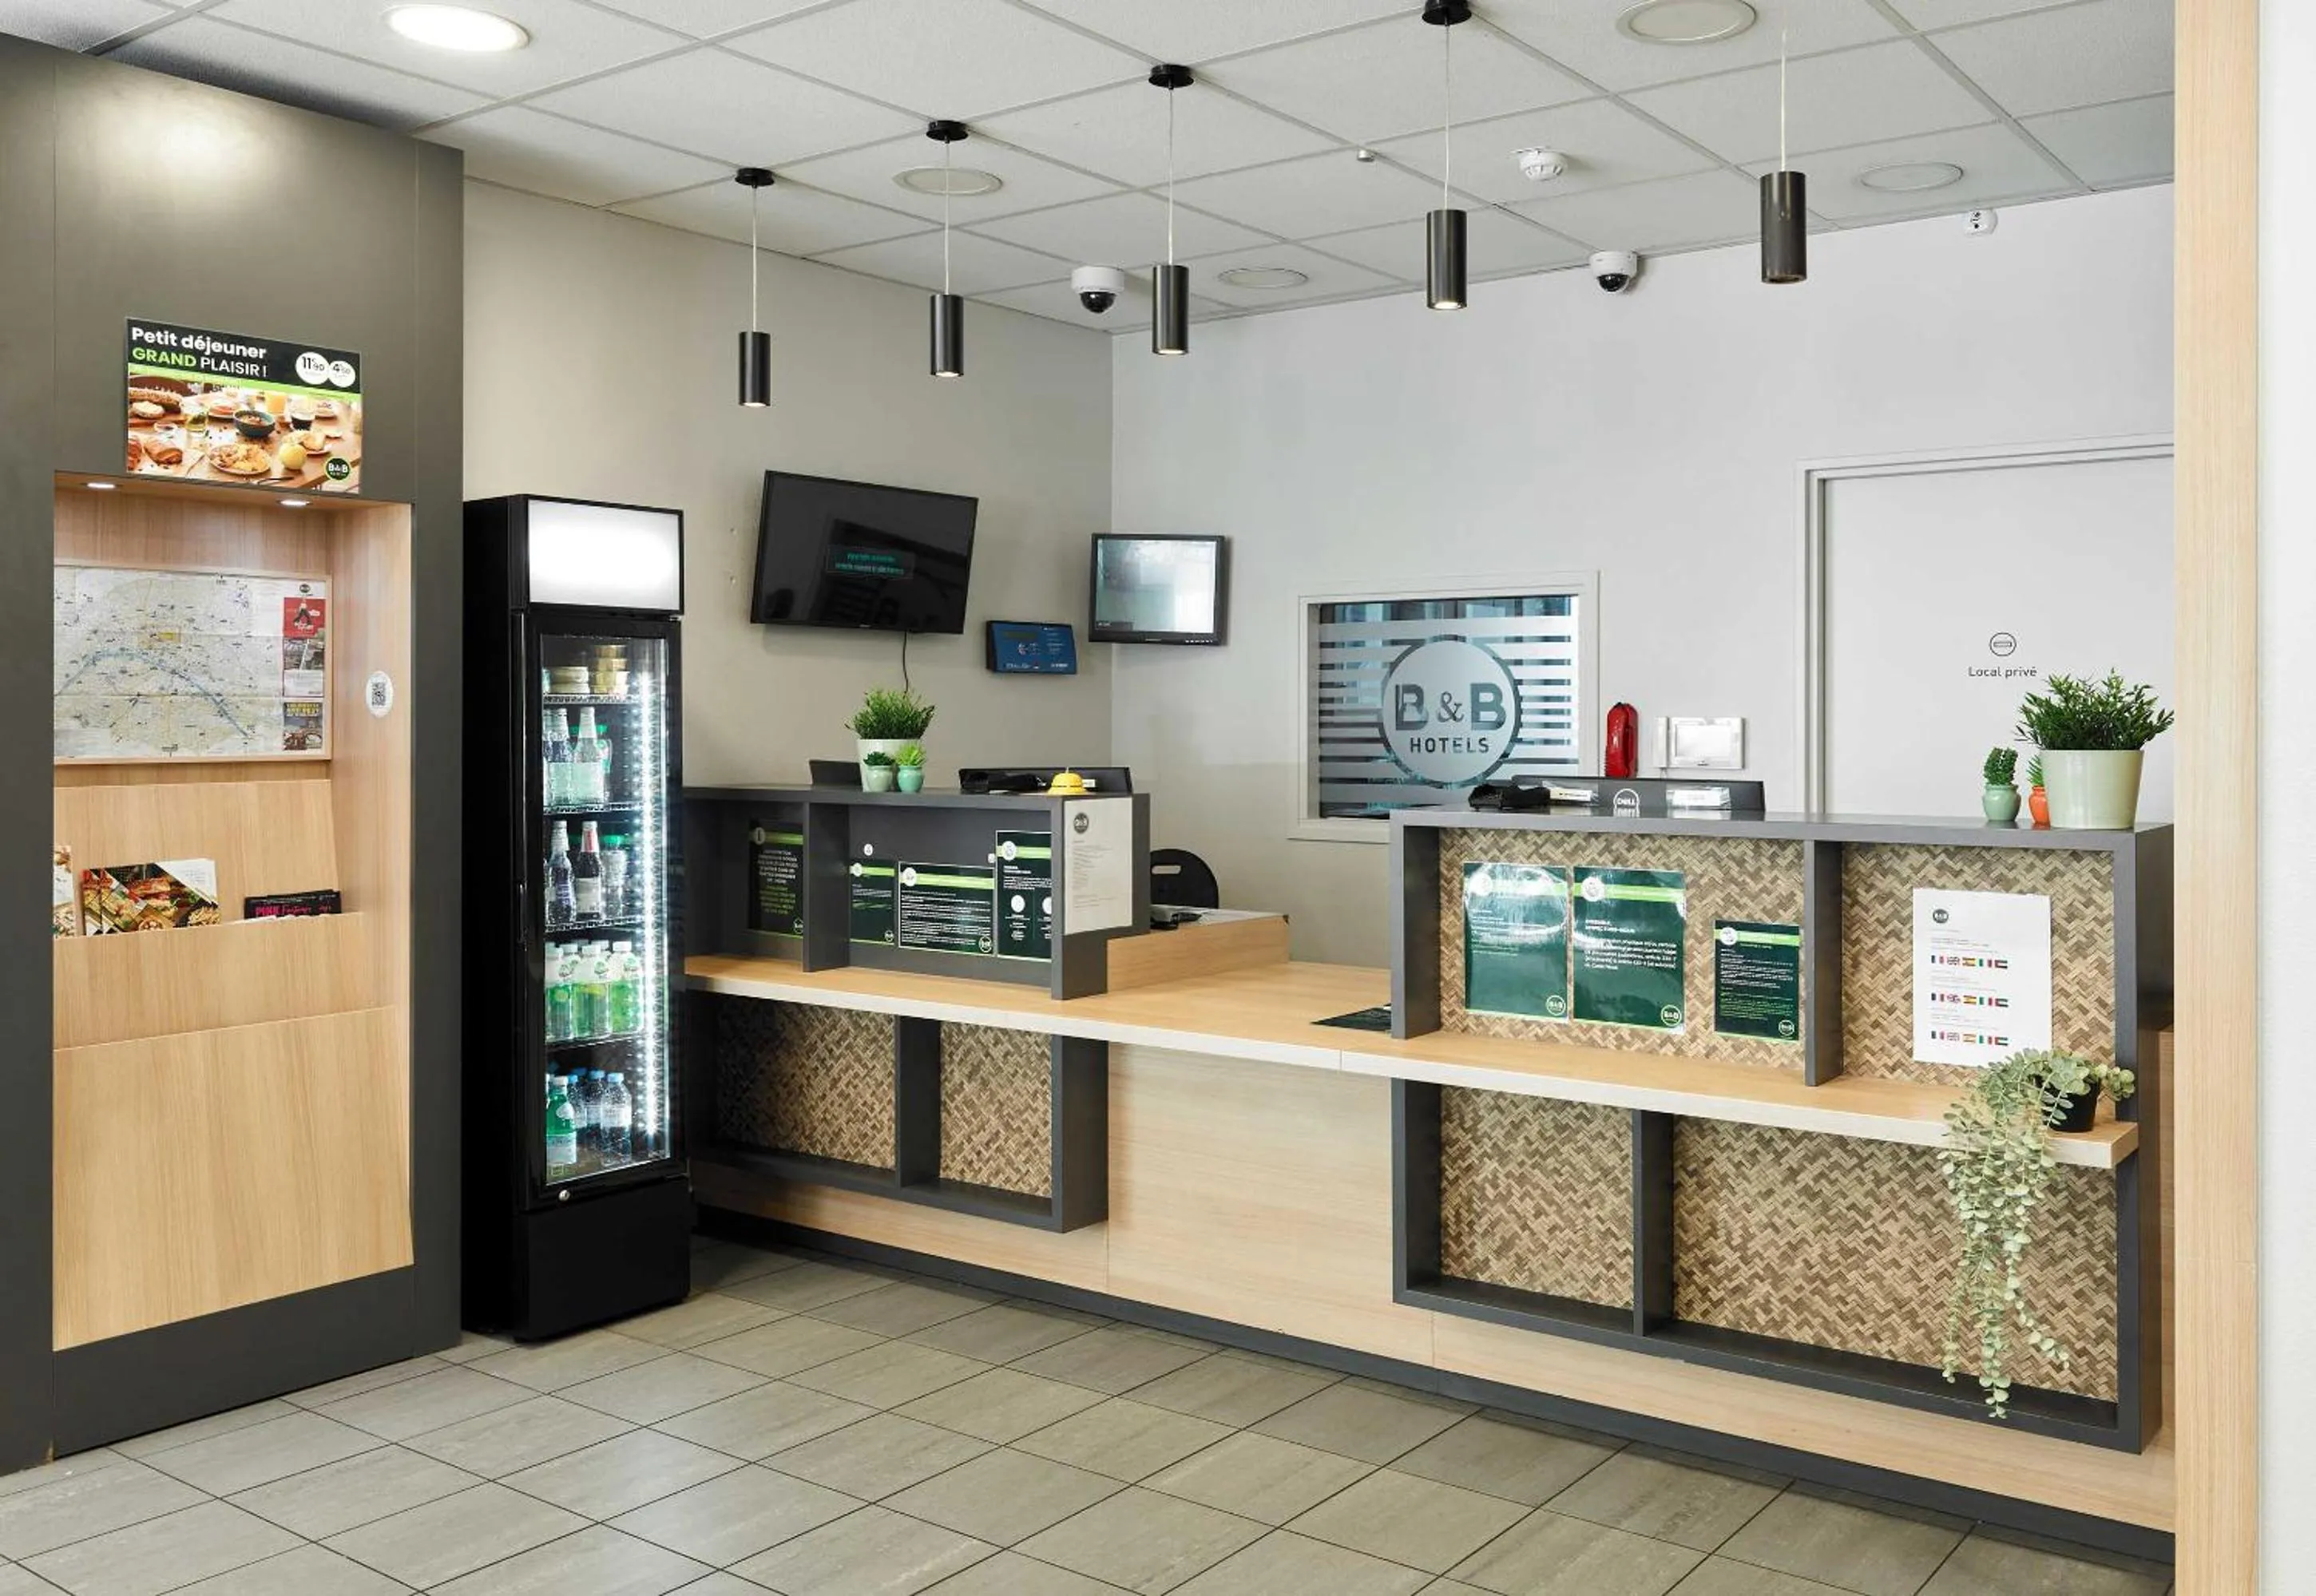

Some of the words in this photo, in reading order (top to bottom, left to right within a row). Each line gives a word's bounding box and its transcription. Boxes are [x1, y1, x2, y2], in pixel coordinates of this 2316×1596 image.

[132, 327, 177, 347] Petit
[180, 335, 267, 358] déjeuner
[132, 347, 196, 367] GRAND
[200, 356, 260, 377] PLAISIR
[1968, 666, 2001, 677] Local
[2005, 666, 2037, 679] privé
[1410, 737, 1489, 754] HOTELS
